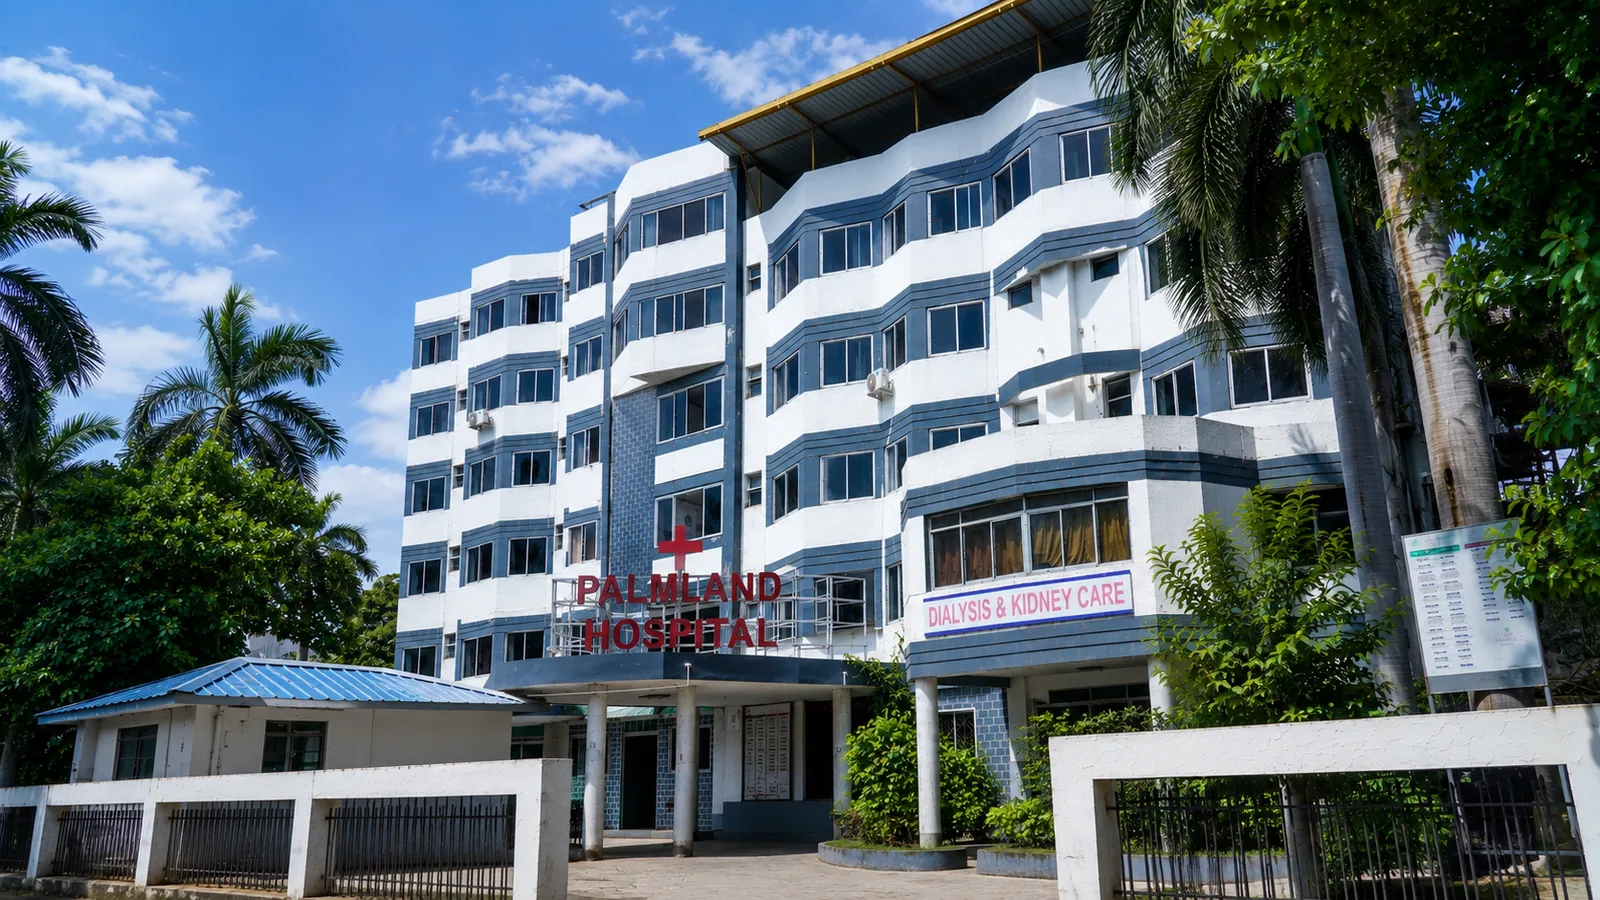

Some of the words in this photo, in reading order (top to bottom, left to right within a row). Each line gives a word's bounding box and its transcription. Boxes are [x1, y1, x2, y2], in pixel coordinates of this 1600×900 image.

[578, 572, 781, 604] PALMLAND
[928, 599, 991, 627] DIALYSIS
[996, 596, 1006, 618] &
[1011, 588, 1072, 616] KIDNEY
[1077, 582, 1125, 608] CARE
[585, 618, 777, 650] HOSPITAL
